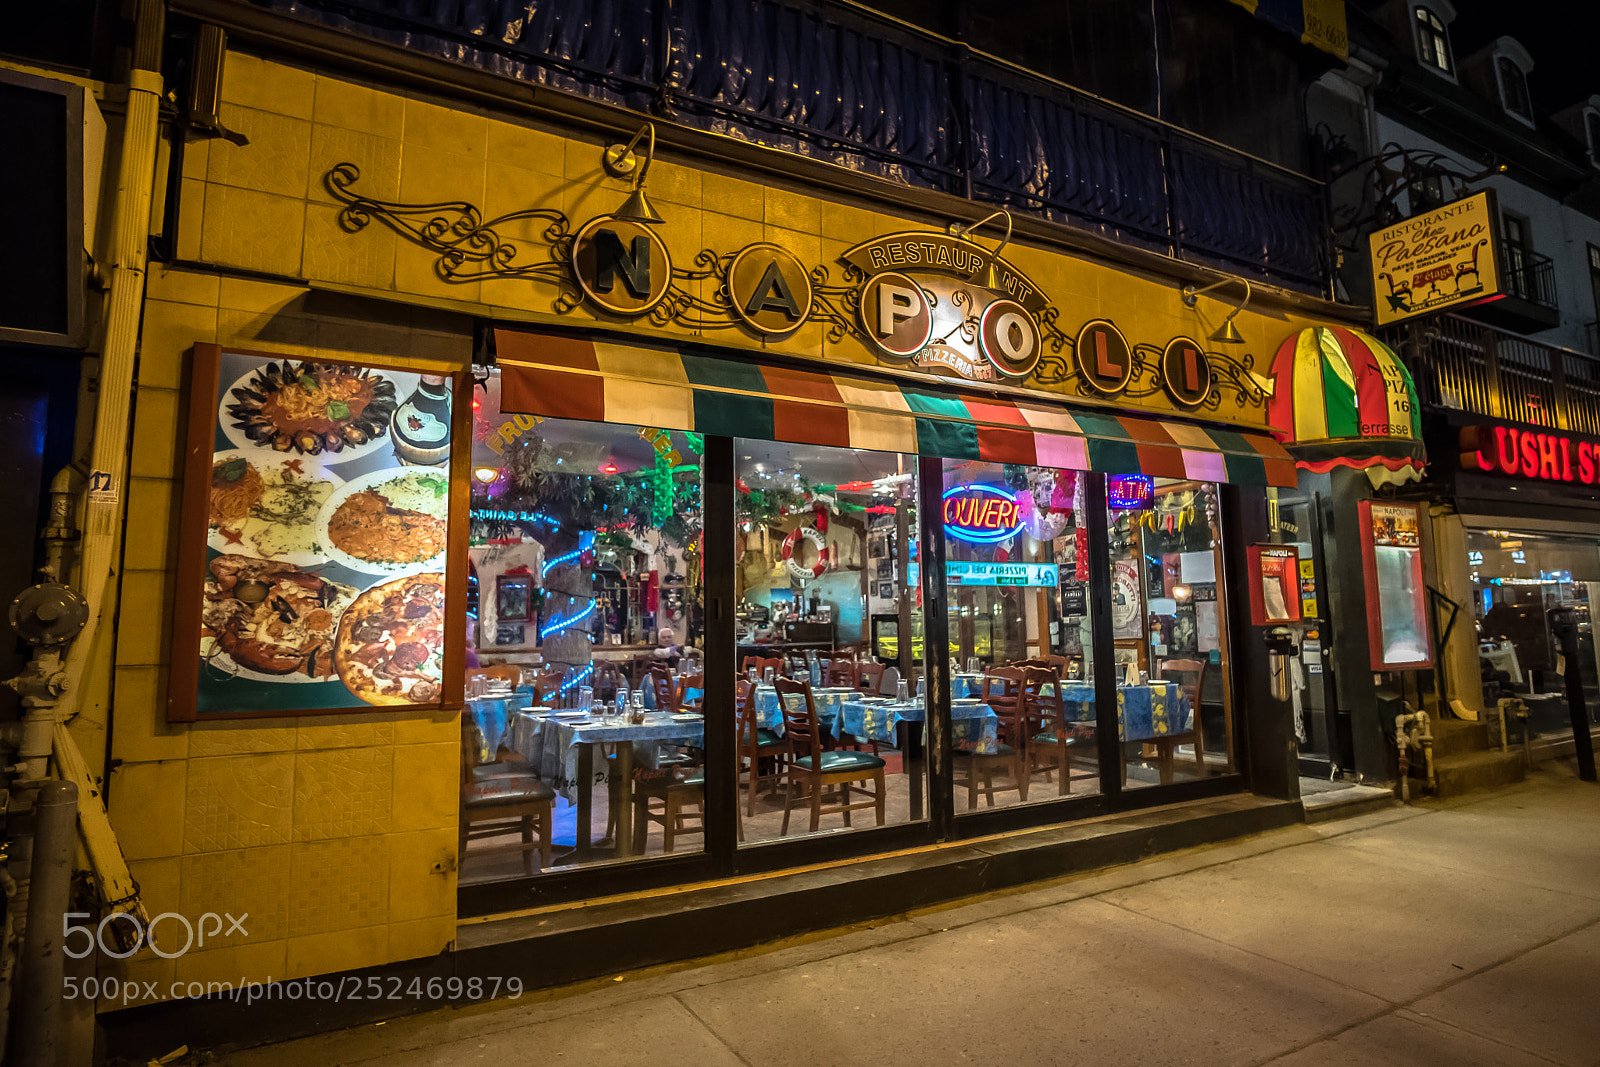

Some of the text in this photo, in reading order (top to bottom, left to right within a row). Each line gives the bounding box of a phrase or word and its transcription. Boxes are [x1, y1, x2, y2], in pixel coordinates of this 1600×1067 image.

[1383, 201, 1475, 241] RISTORANTE
[1377, 224, 1486, 268] Paesano
[1412, 226, 1446, 243] Chez
[868, 242, 1033, 304] RESTAURNT
[922, 349, 973, 377] PIZZERIA
[1393, 399, 1418, 416] 165
[485, 414, 545, 456] FRU
[90, 471, 111, 491] 17
[1116, 481, 1148, 499] ATM
[1310, 665, 1322, 673] VISA
